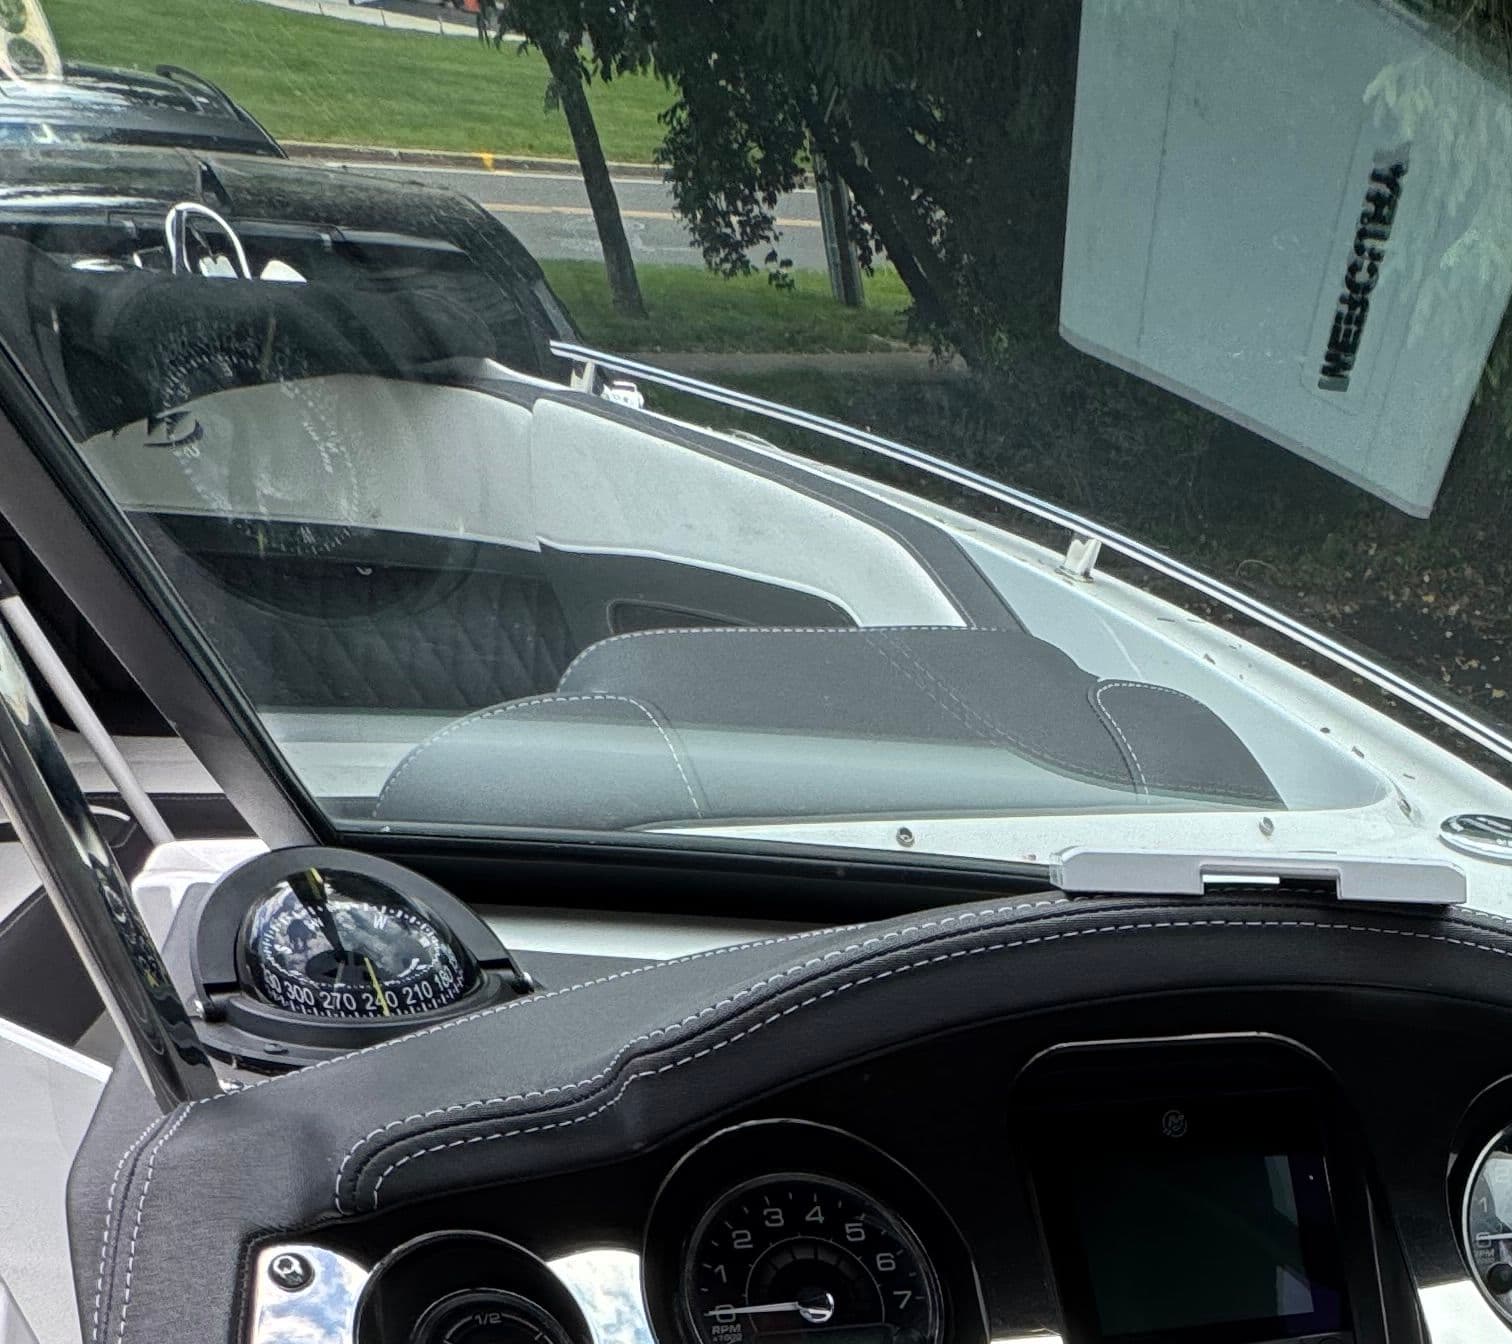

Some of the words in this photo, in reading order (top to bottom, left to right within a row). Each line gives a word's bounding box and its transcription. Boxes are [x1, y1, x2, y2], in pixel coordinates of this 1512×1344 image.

[283, 980, 315, 1006] 300
[318, 990, 357, 1012] 270
[402, 980, 434, 1006] 210
[763, 1207, 785, 1227] 3
[805, 1205, 825, 1224] 4
[732, 1229, 753, 1249] 2
[845, 1222, 866, 1242] 5
[876, 1252, 897, 1272] 6
[713, 1264, 728, 1284] 1
[892, 1290, 912, 1310] 7
[473, 1312, 503, 1325] 1/2
[711, 1324, 742, 1335] RPM
